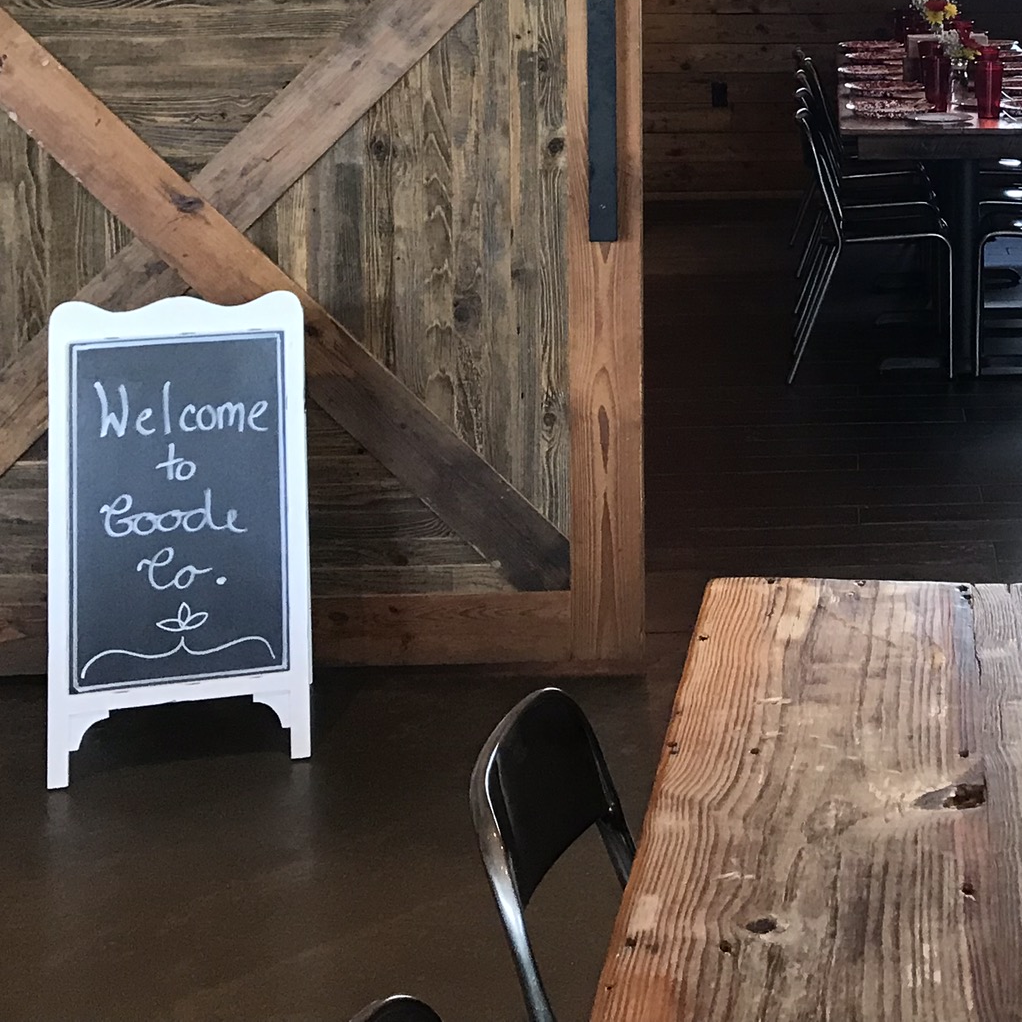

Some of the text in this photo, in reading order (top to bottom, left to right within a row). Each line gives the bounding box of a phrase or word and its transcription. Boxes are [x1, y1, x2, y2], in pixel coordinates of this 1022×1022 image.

[94, 381, 268, 437] Welcome
[155, 443, 196, 480] to
[100, 487, 247, 537] Goode
[137, 547, 226, 589] Co.
